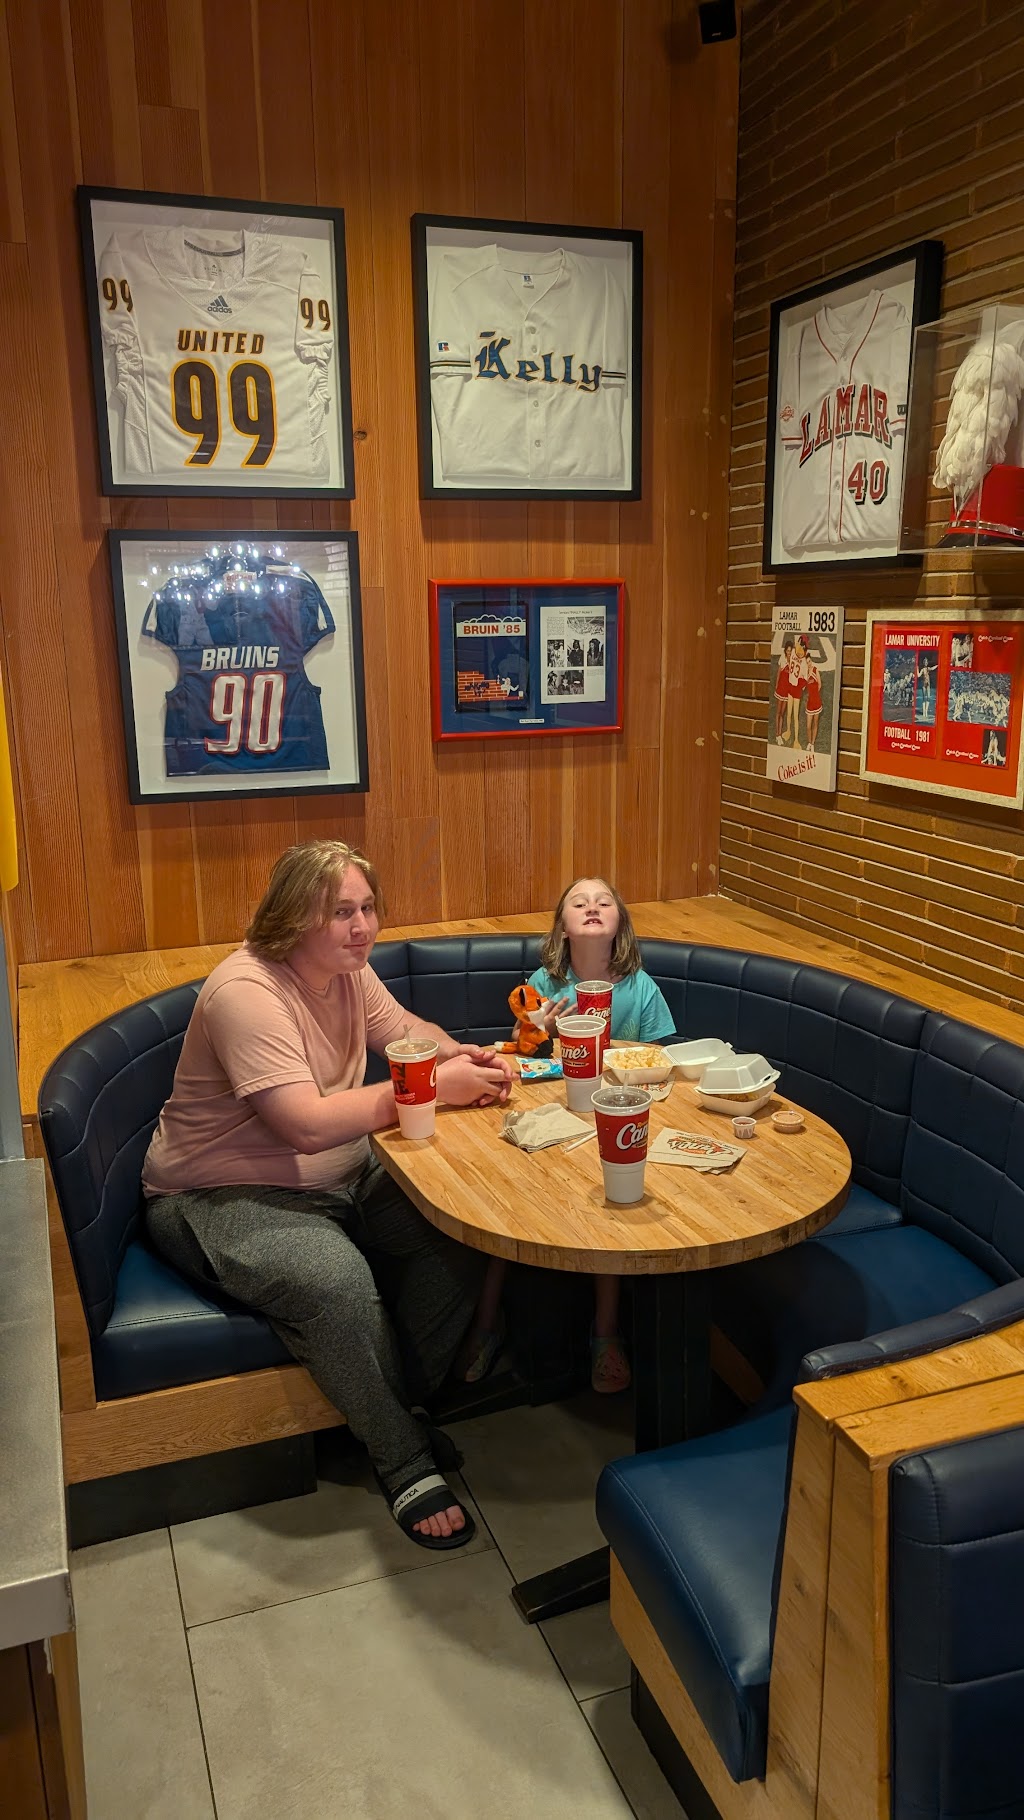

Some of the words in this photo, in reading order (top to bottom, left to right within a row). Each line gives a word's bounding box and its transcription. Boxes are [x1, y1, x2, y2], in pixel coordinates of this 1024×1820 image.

[102, 278, 132, 313] 99
[207, 306, 232, 314] adidas
[299, 297, 331, 332] 99
[177, 328, 265, 355] UNITED
[474, 331, 603, 393] Kelly
[170, 357, 278, 468] 99
[799, 382, 893, 468] LAMAR
[847, 458, 890, 505] 40
[774, 622, 802, 631] FOOTBALL
[779, 611, 798, 620] LAMAR
[808, 611, 835, 632] 1983
[463, 625, 499, 635] BRUIN
[503, 624, 521, 634] '85
[885, 634, 905, 646] LAMAR
[906, 634, 940, 647] UNIVERSITY
[200, 646, 280, 671] BRUINS
[204, 670, 287, 755] 90
[884, 726, 911, 741] FOOTBALL
[915, 730, 930, 743] 1981
[777, 764, 797, 782] Coke
[797, 758, 806, 774] is
[805, 754, 816, 771] it!
[616, 1122, 648, 1151] Can
[395, 1488, 419, 1509] NAUTICA
